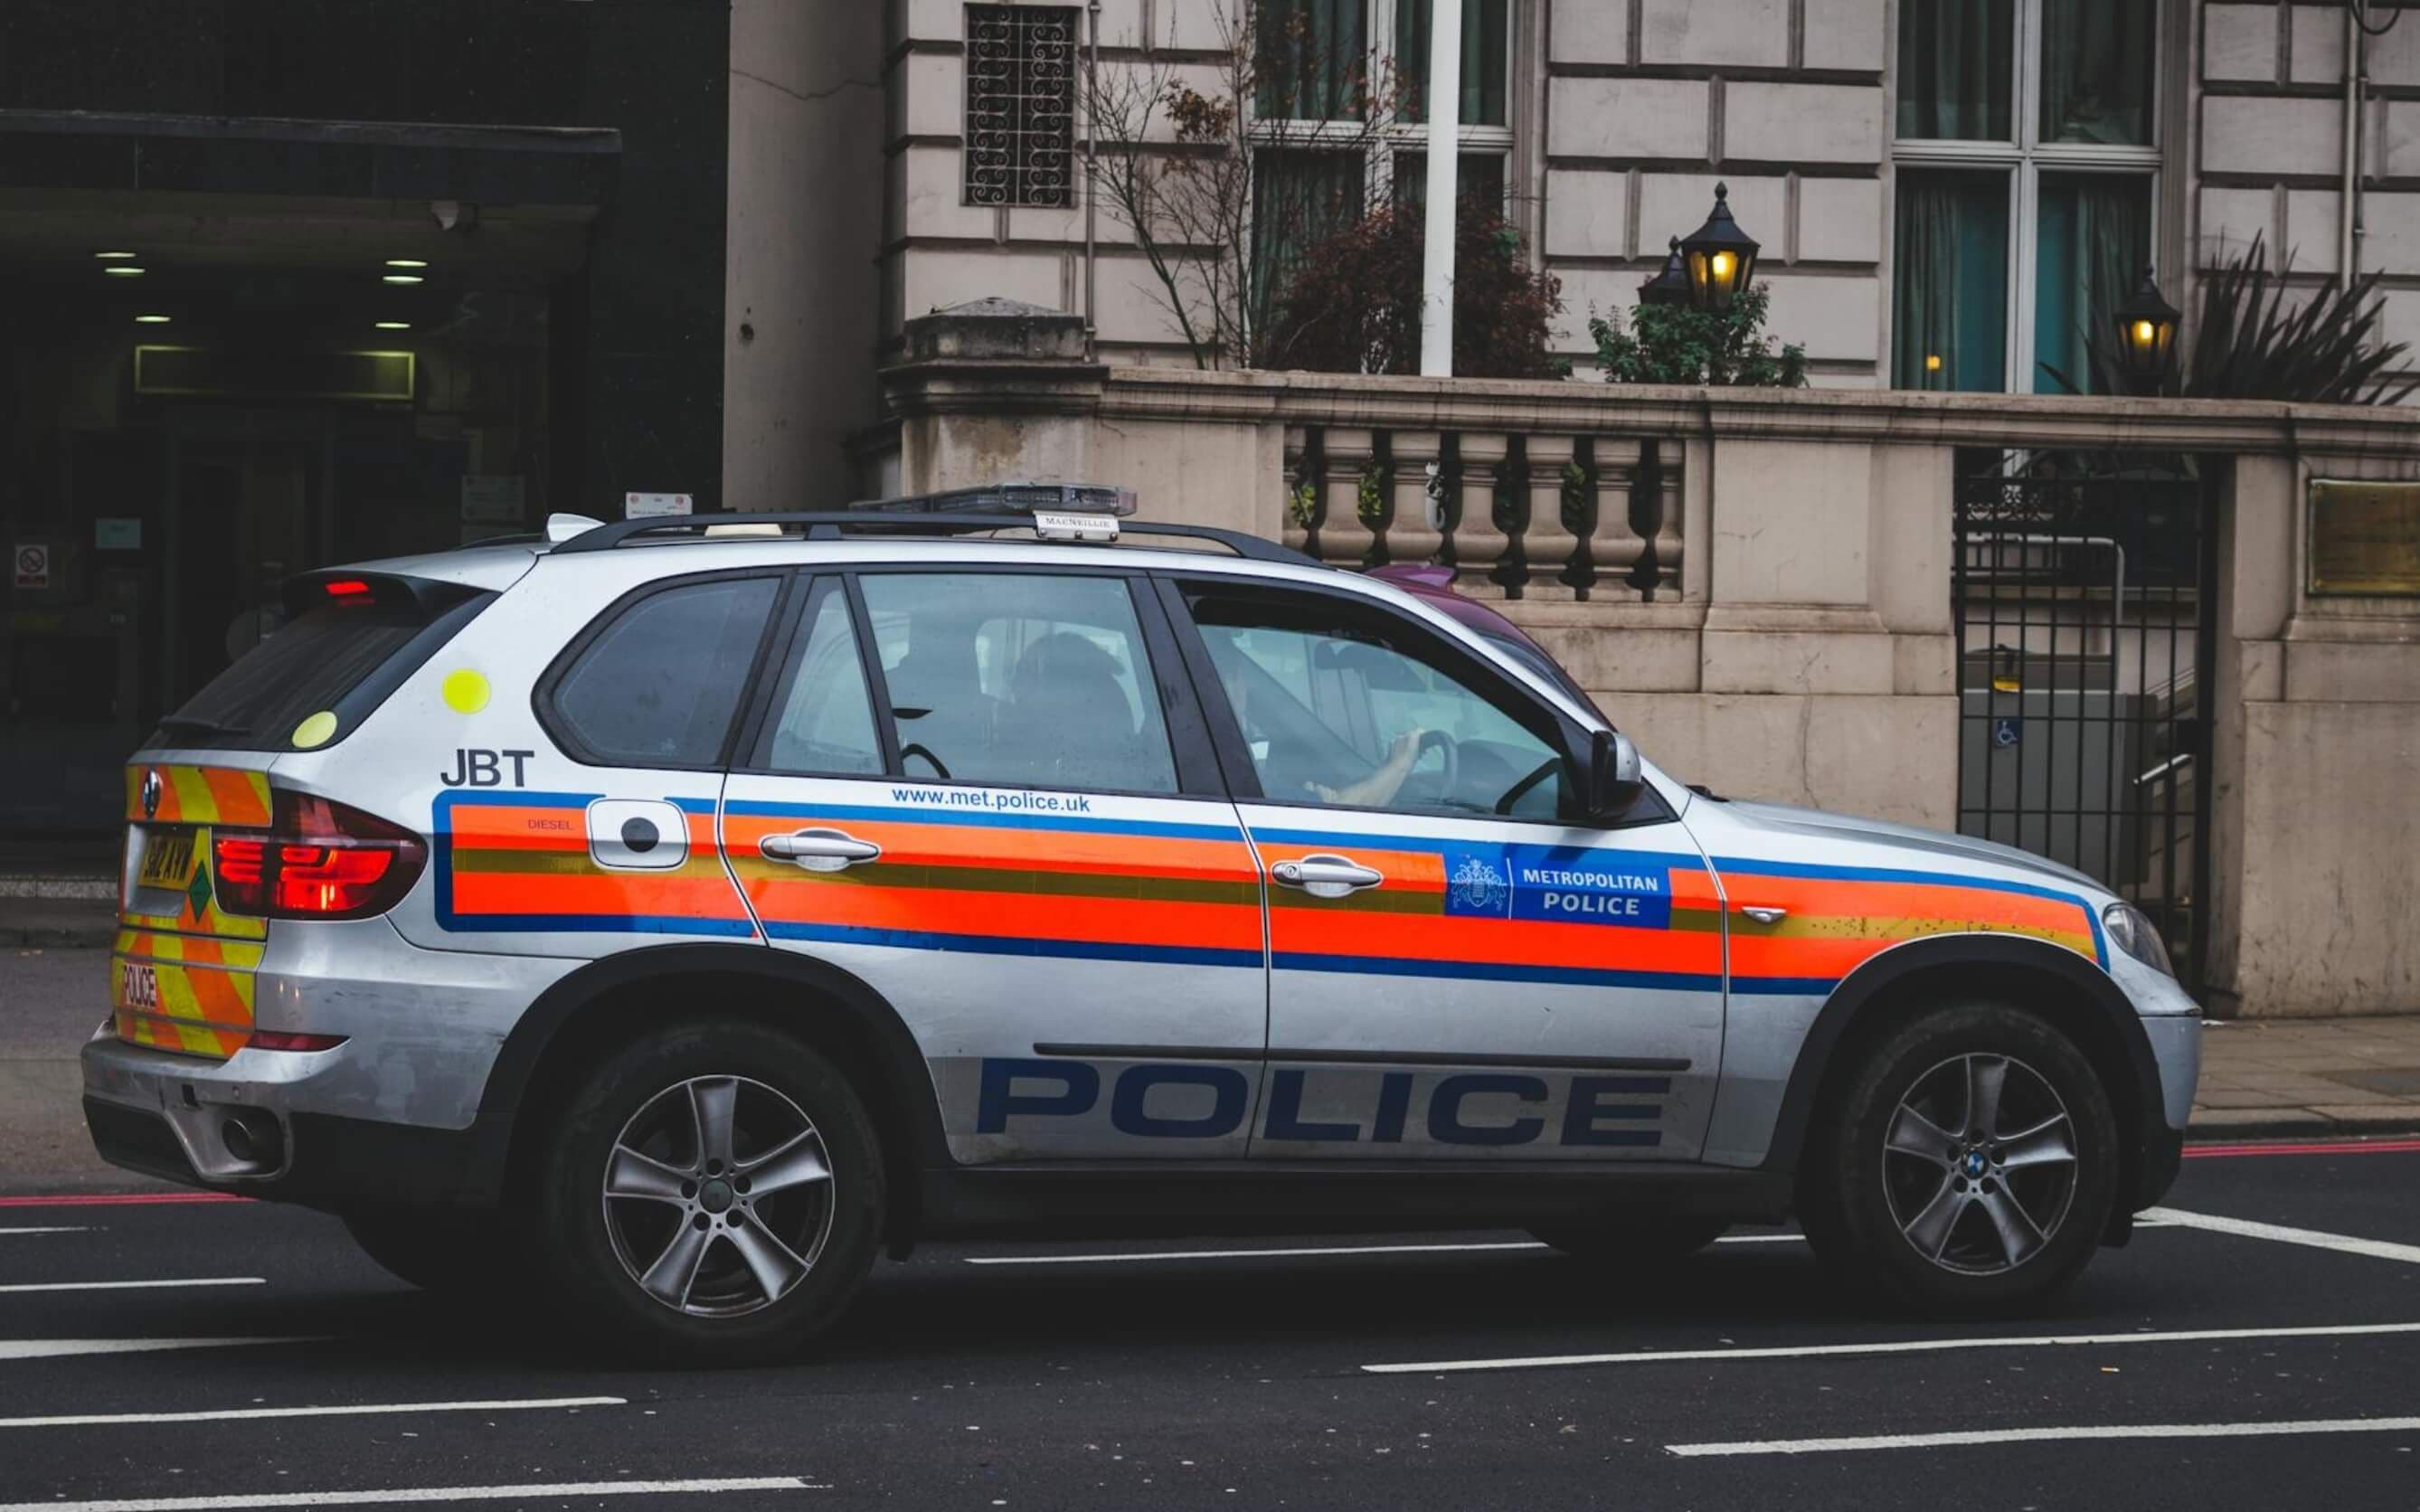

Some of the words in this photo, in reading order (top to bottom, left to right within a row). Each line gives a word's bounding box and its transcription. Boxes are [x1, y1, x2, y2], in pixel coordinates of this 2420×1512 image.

[440, 749, 534, 788] JBT
[892, 788, 1091, 812] www.met.police.uk
[528, 819, 573, 831] DIESEL
[1522, 869, 1659, 892] METROPOLITAN
[1543, 893, 1640, 915] POLICE
[124, 964, 156, 1006] POLICE
[977, 1057, 1671, 1147] POLICE
